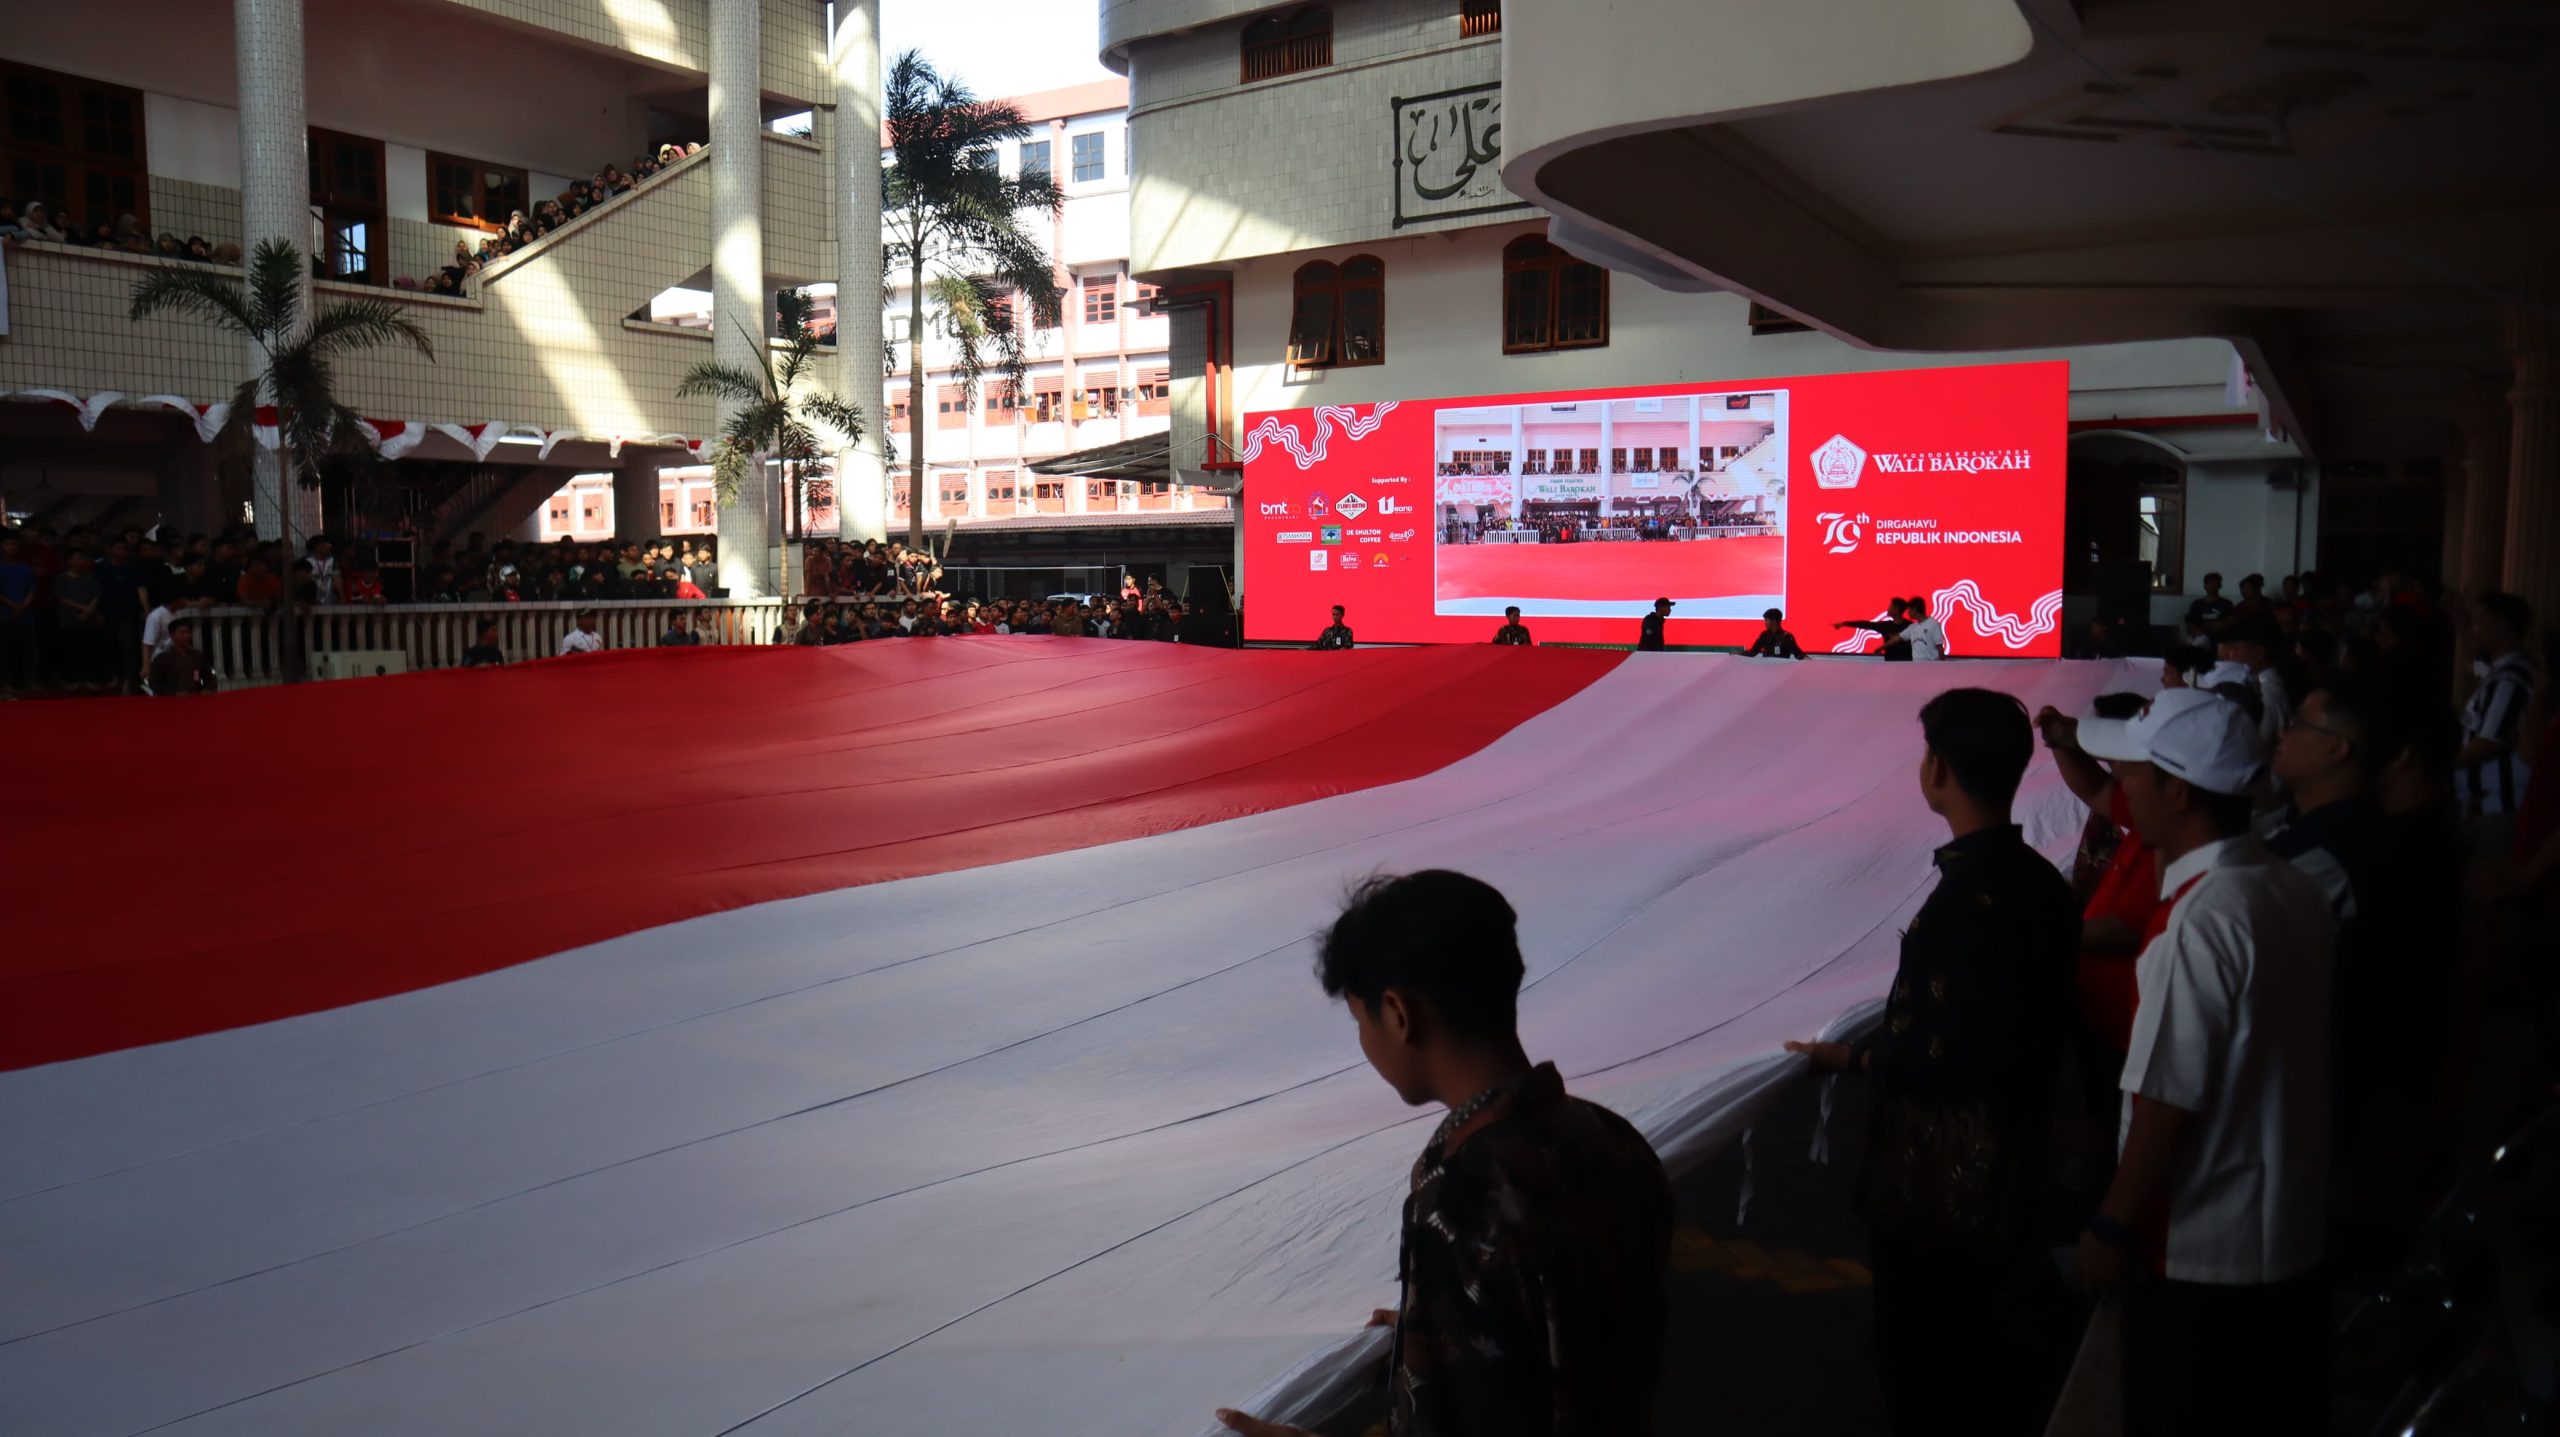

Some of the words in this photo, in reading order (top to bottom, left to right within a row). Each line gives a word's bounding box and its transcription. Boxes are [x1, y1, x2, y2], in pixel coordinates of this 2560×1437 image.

[1955, 449, 2029, 457] PESANTREN
[1872, 454, 1924, 473] WALI
[1929, 454, 2031, 474] BAROKAH
[1371, 476, 1399, 485] Supported
[1876, 519, 1937, 529] DIRGAHAYU
[1875, 532, 1941, 544] REPUBLIK
[1944, 531, 2022, 544] INDONESIA
